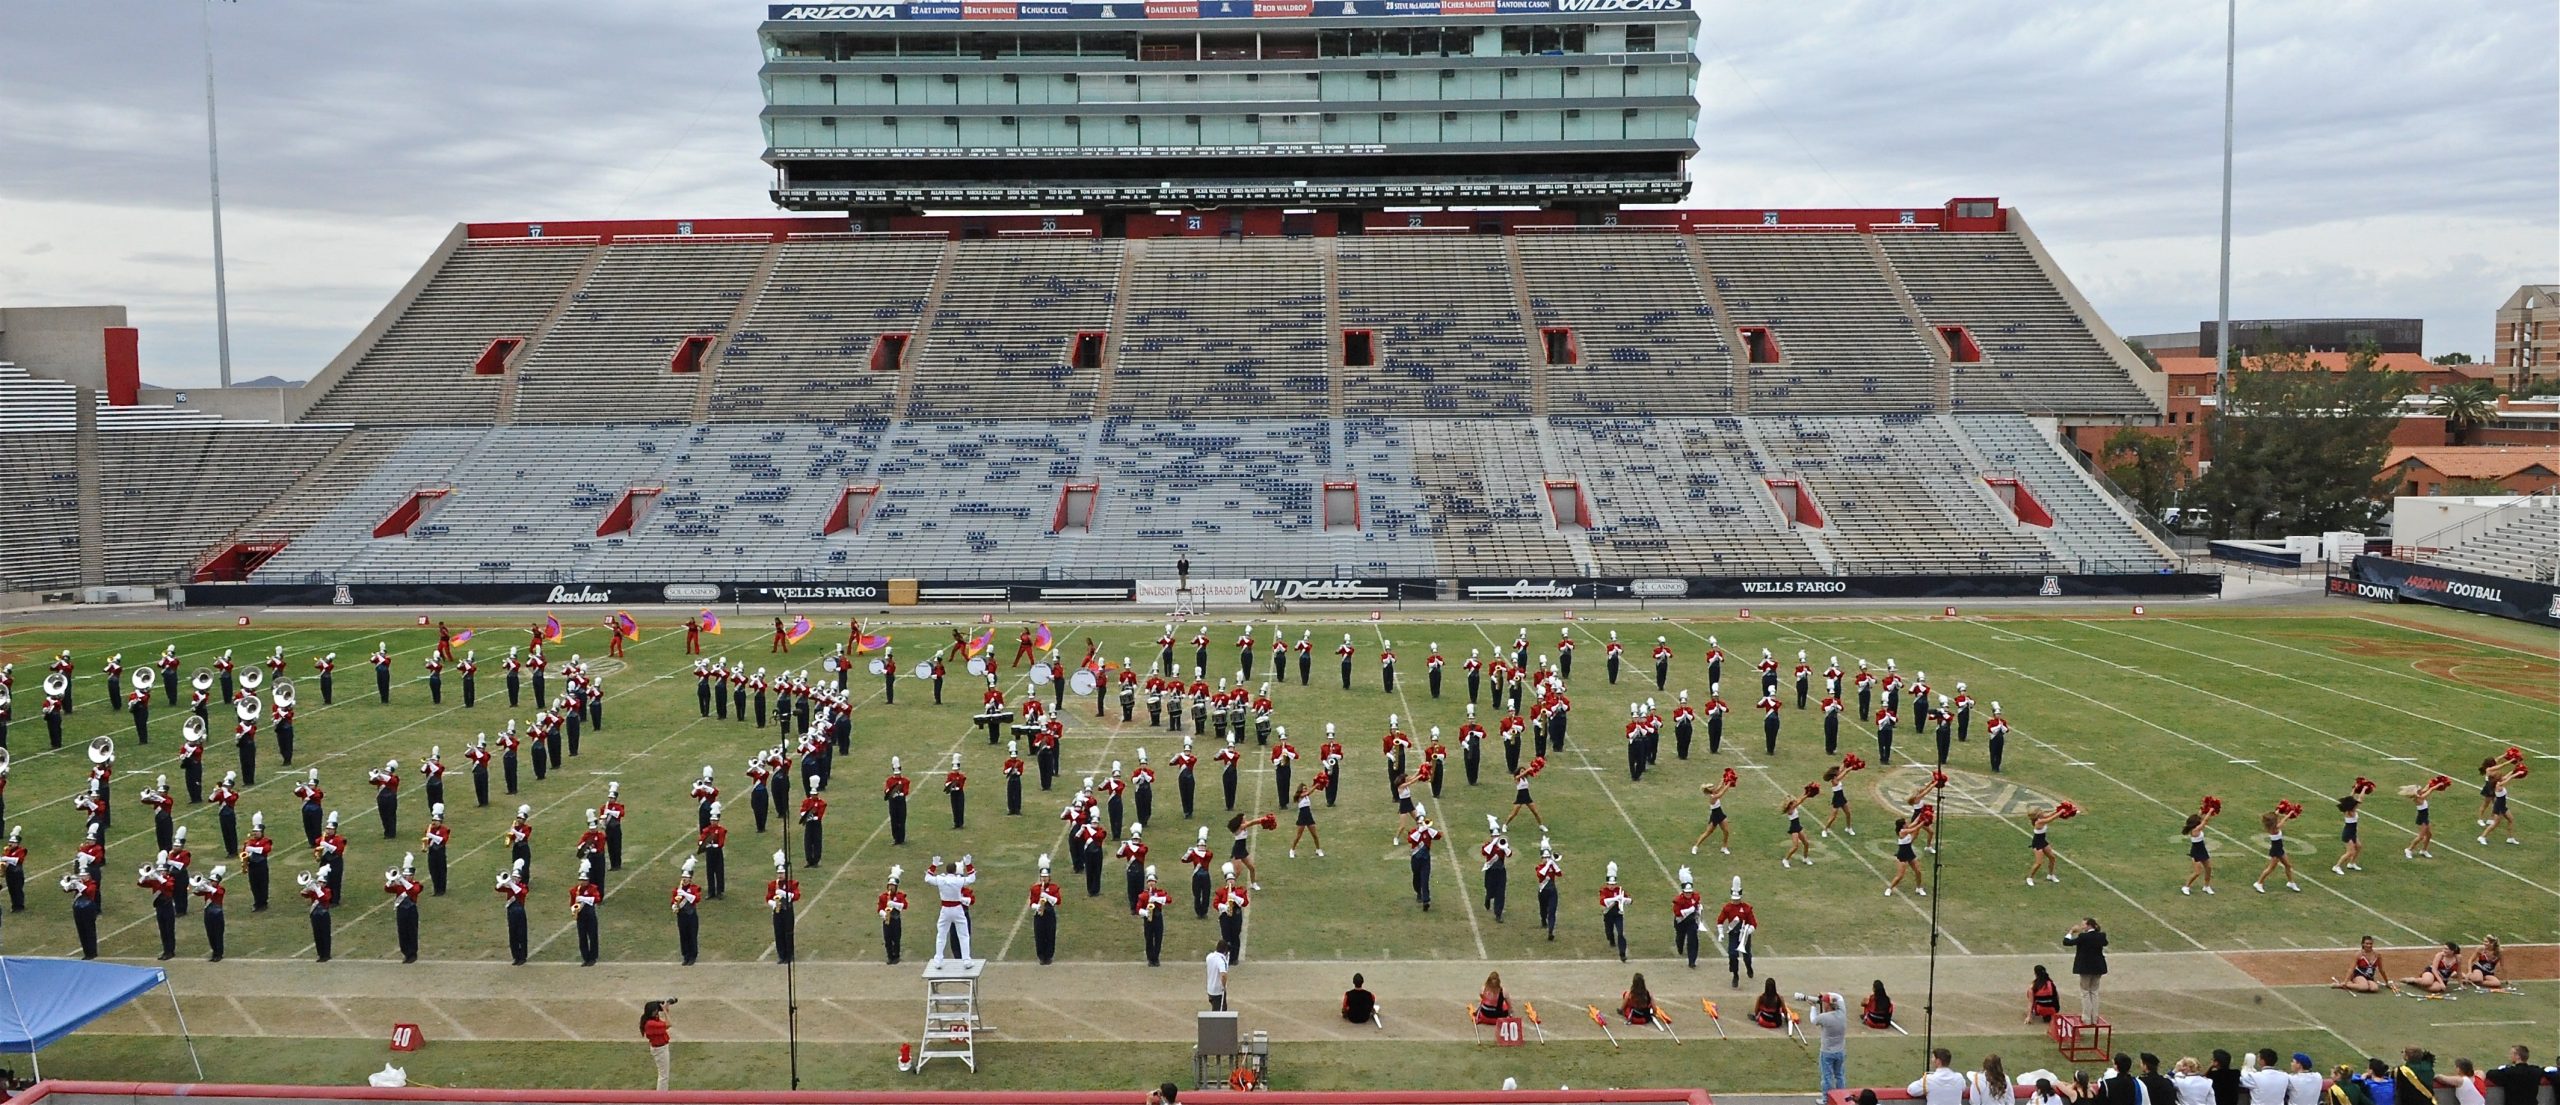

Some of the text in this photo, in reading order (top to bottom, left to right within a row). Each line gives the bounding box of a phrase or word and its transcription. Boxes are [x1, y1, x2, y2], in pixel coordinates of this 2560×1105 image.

[911, 6, 918, 14] 22
[972, 6, 991, 14] RICKY
[992, 6, 1016, 14] HUNLEY
[1558, 0, 1682, 11] WILDCATS
[781, 6, 896, 19] ARIZONA
[1043, 222, 1056, 230] 20
[1189, 220, 1200, 229] 21
[1409, 218, 1421, 227] 22
[1605, 217, 1617, 225] 23
[530, 229, 541, 237] 17
[680, 226, 691, 234] 18
[851, 224, 861, 232] 19
[176, 393, 186, 401] 16
[773, 587, 876, 598] WELLS FARGO
[1140, 586, 1173, 596] UNIVERSITY
[1214, 585, 1232, 596] BAND
[1234, 585, 1247, 595] DAY
[1742, 582, 1846, 593] WELLS FARGO
[2331, 577, 2393, 600] BEAR DOWN
[2405, 575, 2502, 602] ARIZONA FOOTBALL
[546, 585, 611, 603] Bashas'
[1500, 1022, 1519, 1041] 40
[393, 1027, 411, 1047] 40
